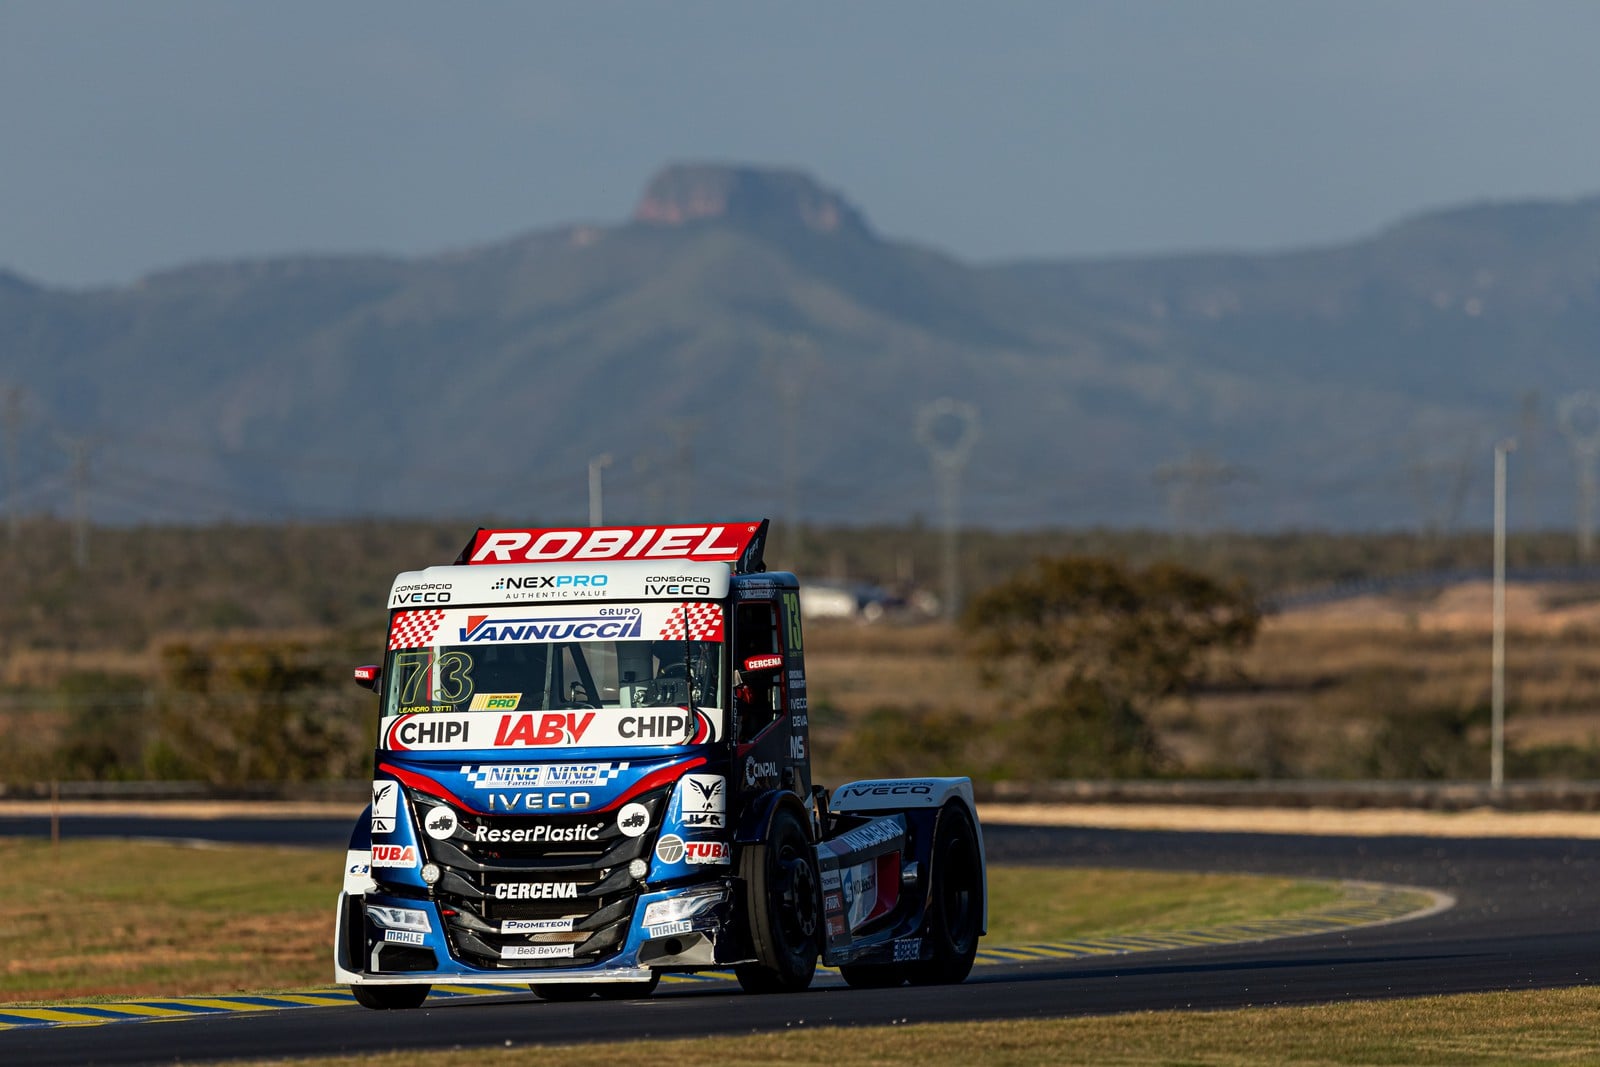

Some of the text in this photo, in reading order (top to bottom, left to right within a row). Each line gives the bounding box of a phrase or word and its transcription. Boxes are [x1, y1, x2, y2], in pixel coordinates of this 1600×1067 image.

[470, 527, 738, 562] ROBIEL
[506, 575, 608, 589] NEXPRO
[646, 575, 711, 584] CONSÓRCIO
[395, 583, 452, 593] CONSÓRCIO
[644, 584, 710, 596] IVECO
[393, 592, 451, 605] IVECO
[506, 591, 568, 599] AUTHENTIC
[599, 608, 641, 616] GRUPO
[749, 658, 782, 669] CERCENA
[396, 651, 475, 705] 73
[399, 705, 452, 714] LEANDRO TOTTI
[487, 699, 516, 708] PRO
[400, 721, 469, 745] CHIPI
[843, 786, 931, 798] IVECO
[488, 792, 591, 810] IVECO
[475, 825, 600, 842] ReserPlastic
[372, 846, 415, 861] TUBA
[686, 843, 730, 859] TUBA
[495, 882, 578, 899] CERCENA
[505, 921, 571, 929] PROMETEON
[651, 921, 690, 937] MAHLE
[386, 931, 422, 943] MAHLE
[517, 946, 571, 955] Be8 BeVant
